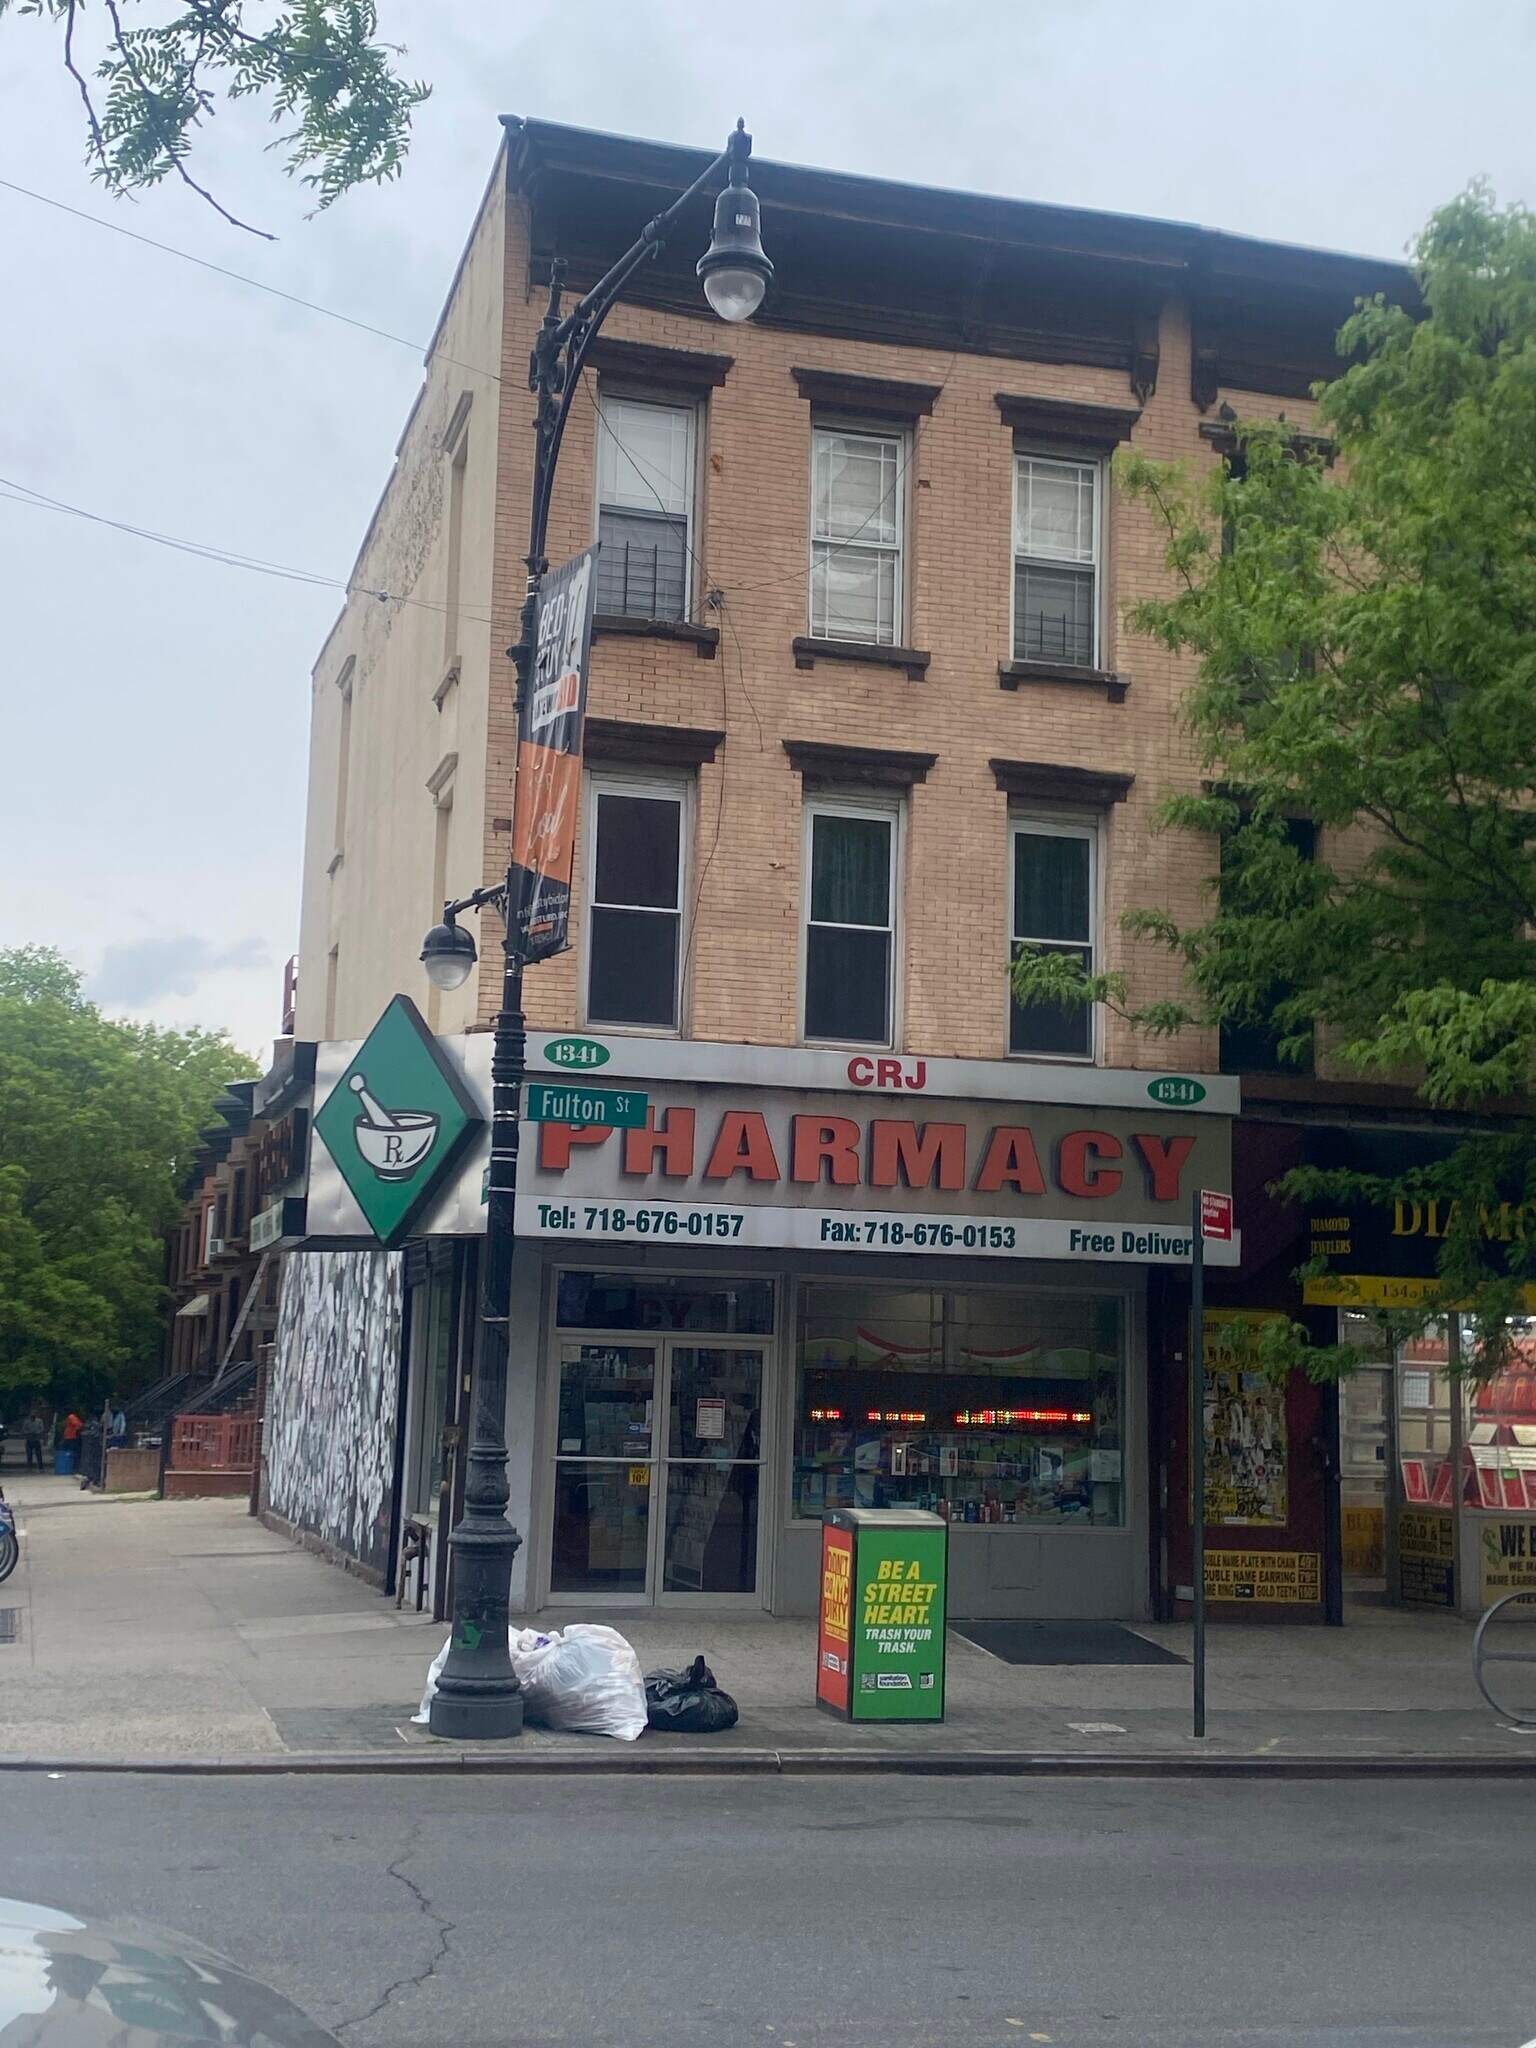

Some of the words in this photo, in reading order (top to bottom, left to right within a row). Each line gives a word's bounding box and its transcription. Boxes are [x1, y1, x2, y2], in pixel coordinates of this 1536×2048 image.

[538, 592, 567, 647] BED-
[554, 1044, 597, 1063] 1341
[847, 1056, 926, 1090] CRJ
[1157, 1082, 1195, 1100] 1341
[542, 1090, 605, 1120] Fulton
[616, 1096, 630, 1113] St
[540, 1105, 1197, 1200] PHARMACY
[538, 1204, 576, 1229] Tel:
[583, 1207, 744, 1237] 718-676-0157
[1310, 1217, 1350, 1232] DIAMOND
[1070, 1229, 1115, 1253] Free
[1121, 1230, 1204, 1256] Deliver
[1310, 1239, 1351, 1256] JEWELERS
[1499, 1525, 1525, 1557] WE
[878, 1561, 904, 1580] BE
[907, 1561, 920, 1580] A
[1205, 1554, 1221, 1567] UBLE
[1241, 1555, 1259, 1568] PLATE
[1204, 1570, 1231, 1582] OUBLE
[1233, 1571, 1257, 1582] NAME
[1259, 1571, 1296, 1583] EARRING
[834, 1574, 849, 1604] NYC
[864, 1584, 937, 1602] STREET
[1276, 1586, 1297, 1599] TEETH
[864, 1605, 930, 1625] HEART.
[865, 1629, 902, 1640] TRASH
[903, 1629, 932, 1640] YOUR
[878, 1642, 917, 1654] TRASH.
